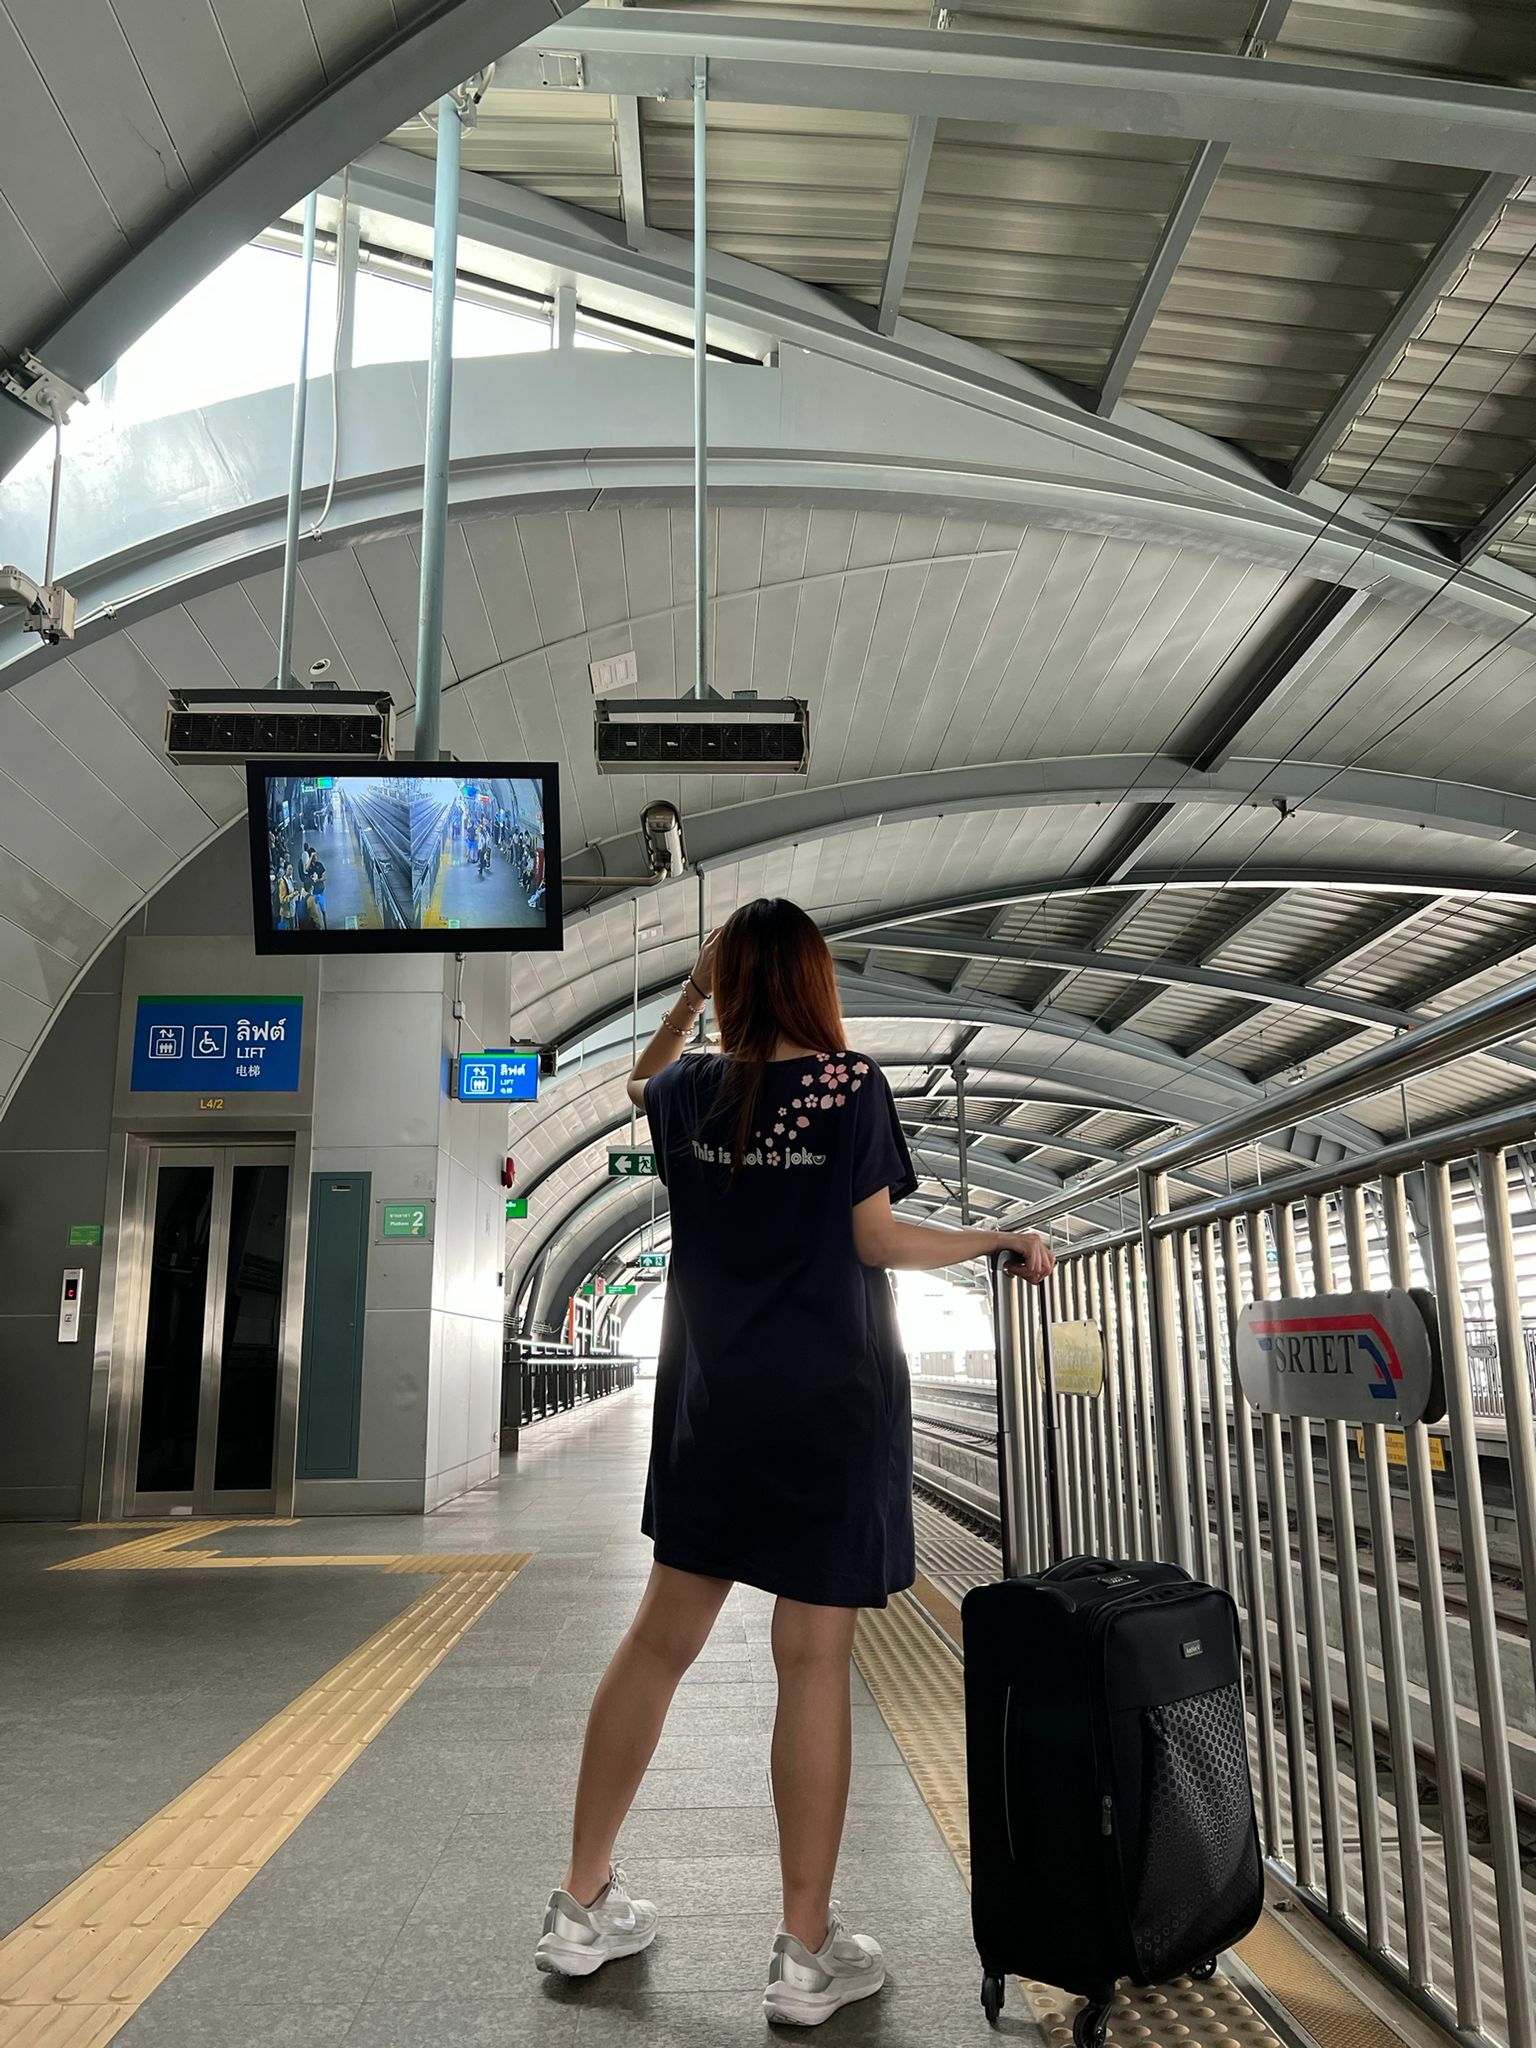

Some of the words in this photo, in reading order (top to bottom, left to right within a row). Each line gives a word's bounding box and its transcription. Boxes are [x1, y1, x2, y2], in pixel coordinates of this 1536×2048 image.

[236, 1018, 287, 1041] ลิฟต์
[236, 1047, 266, 1059] LIFT
[235, 1064, 261, 1077] 电梯
[200, 1098, 224, 1109] L4/2
[692, 1140, 715, 1162] This
[718, 1146, 732, 1165] is
[412, 1210, 424, 1227] 2
[1274, 1334, 1356, 1375] SRTET
